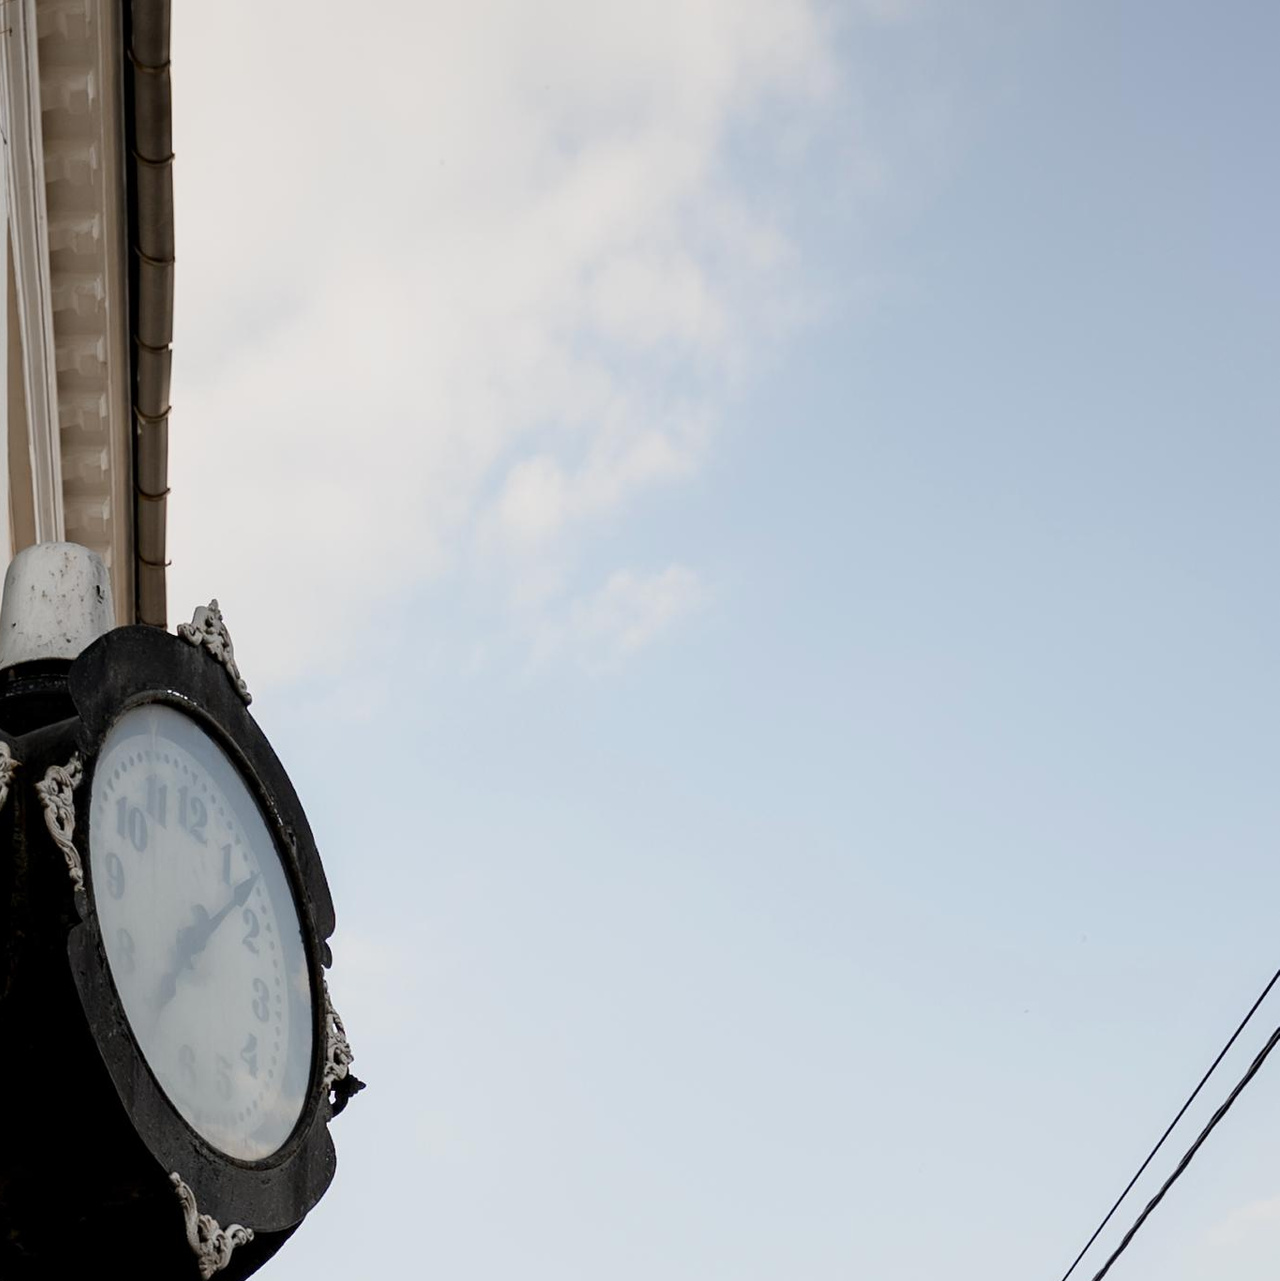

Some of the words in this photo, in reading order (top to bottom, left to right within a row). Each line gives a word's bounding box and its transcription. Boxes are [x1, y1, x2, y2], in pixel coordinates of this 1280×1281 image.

[116, 795, 149, 852] 10
[144, 773, 169, 829] 11
[177, 785, 209, 846] 12
[106, 852, 126, 900] 9
[220, 843, 233, 886] 1
[243, 908, 261, 955] 2
[252, 977, 271, 1024] 3
[241, 1033, 259, 1077] 4
